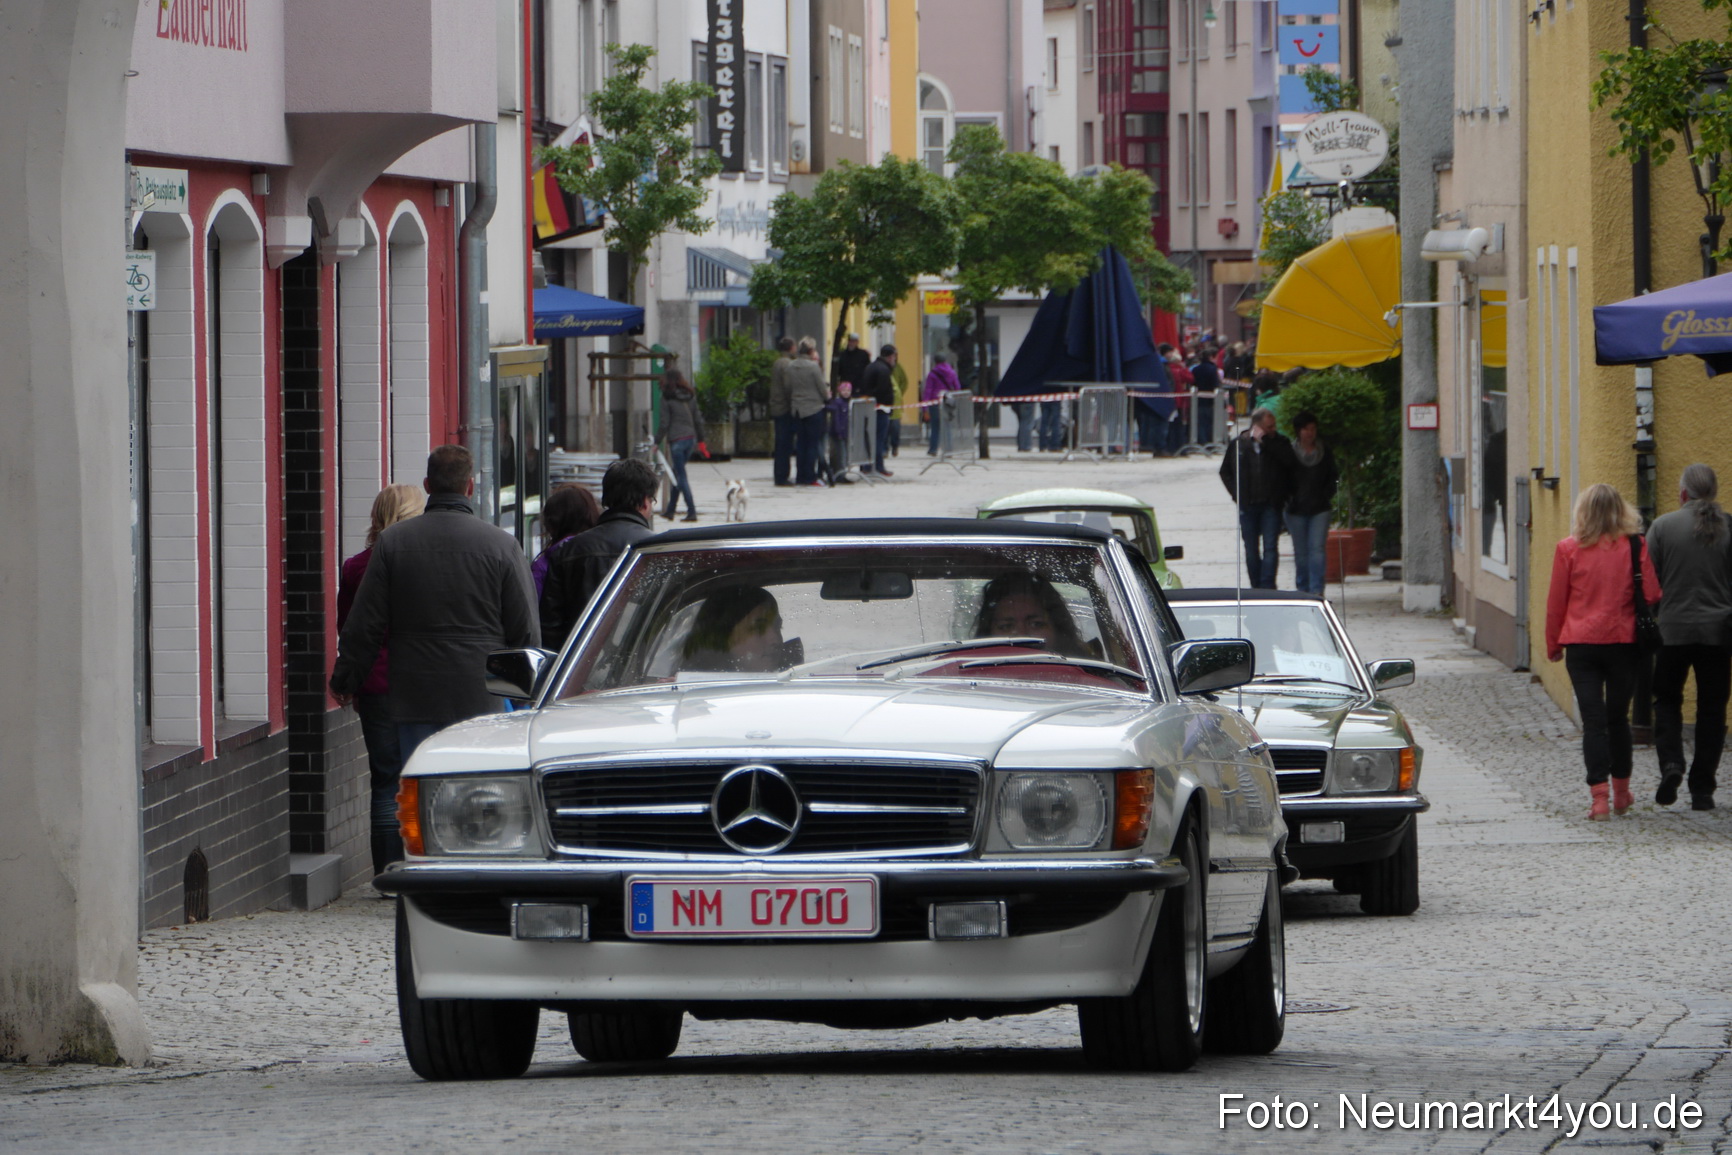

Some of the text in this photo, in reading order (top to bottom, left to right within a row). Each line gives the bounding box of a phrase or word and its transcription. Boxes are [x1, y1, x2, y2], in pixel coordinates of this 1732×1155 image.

[1305, 118, 1381, 143] Woll-Traum
[638, 887, 848, 926] D NM 0700
